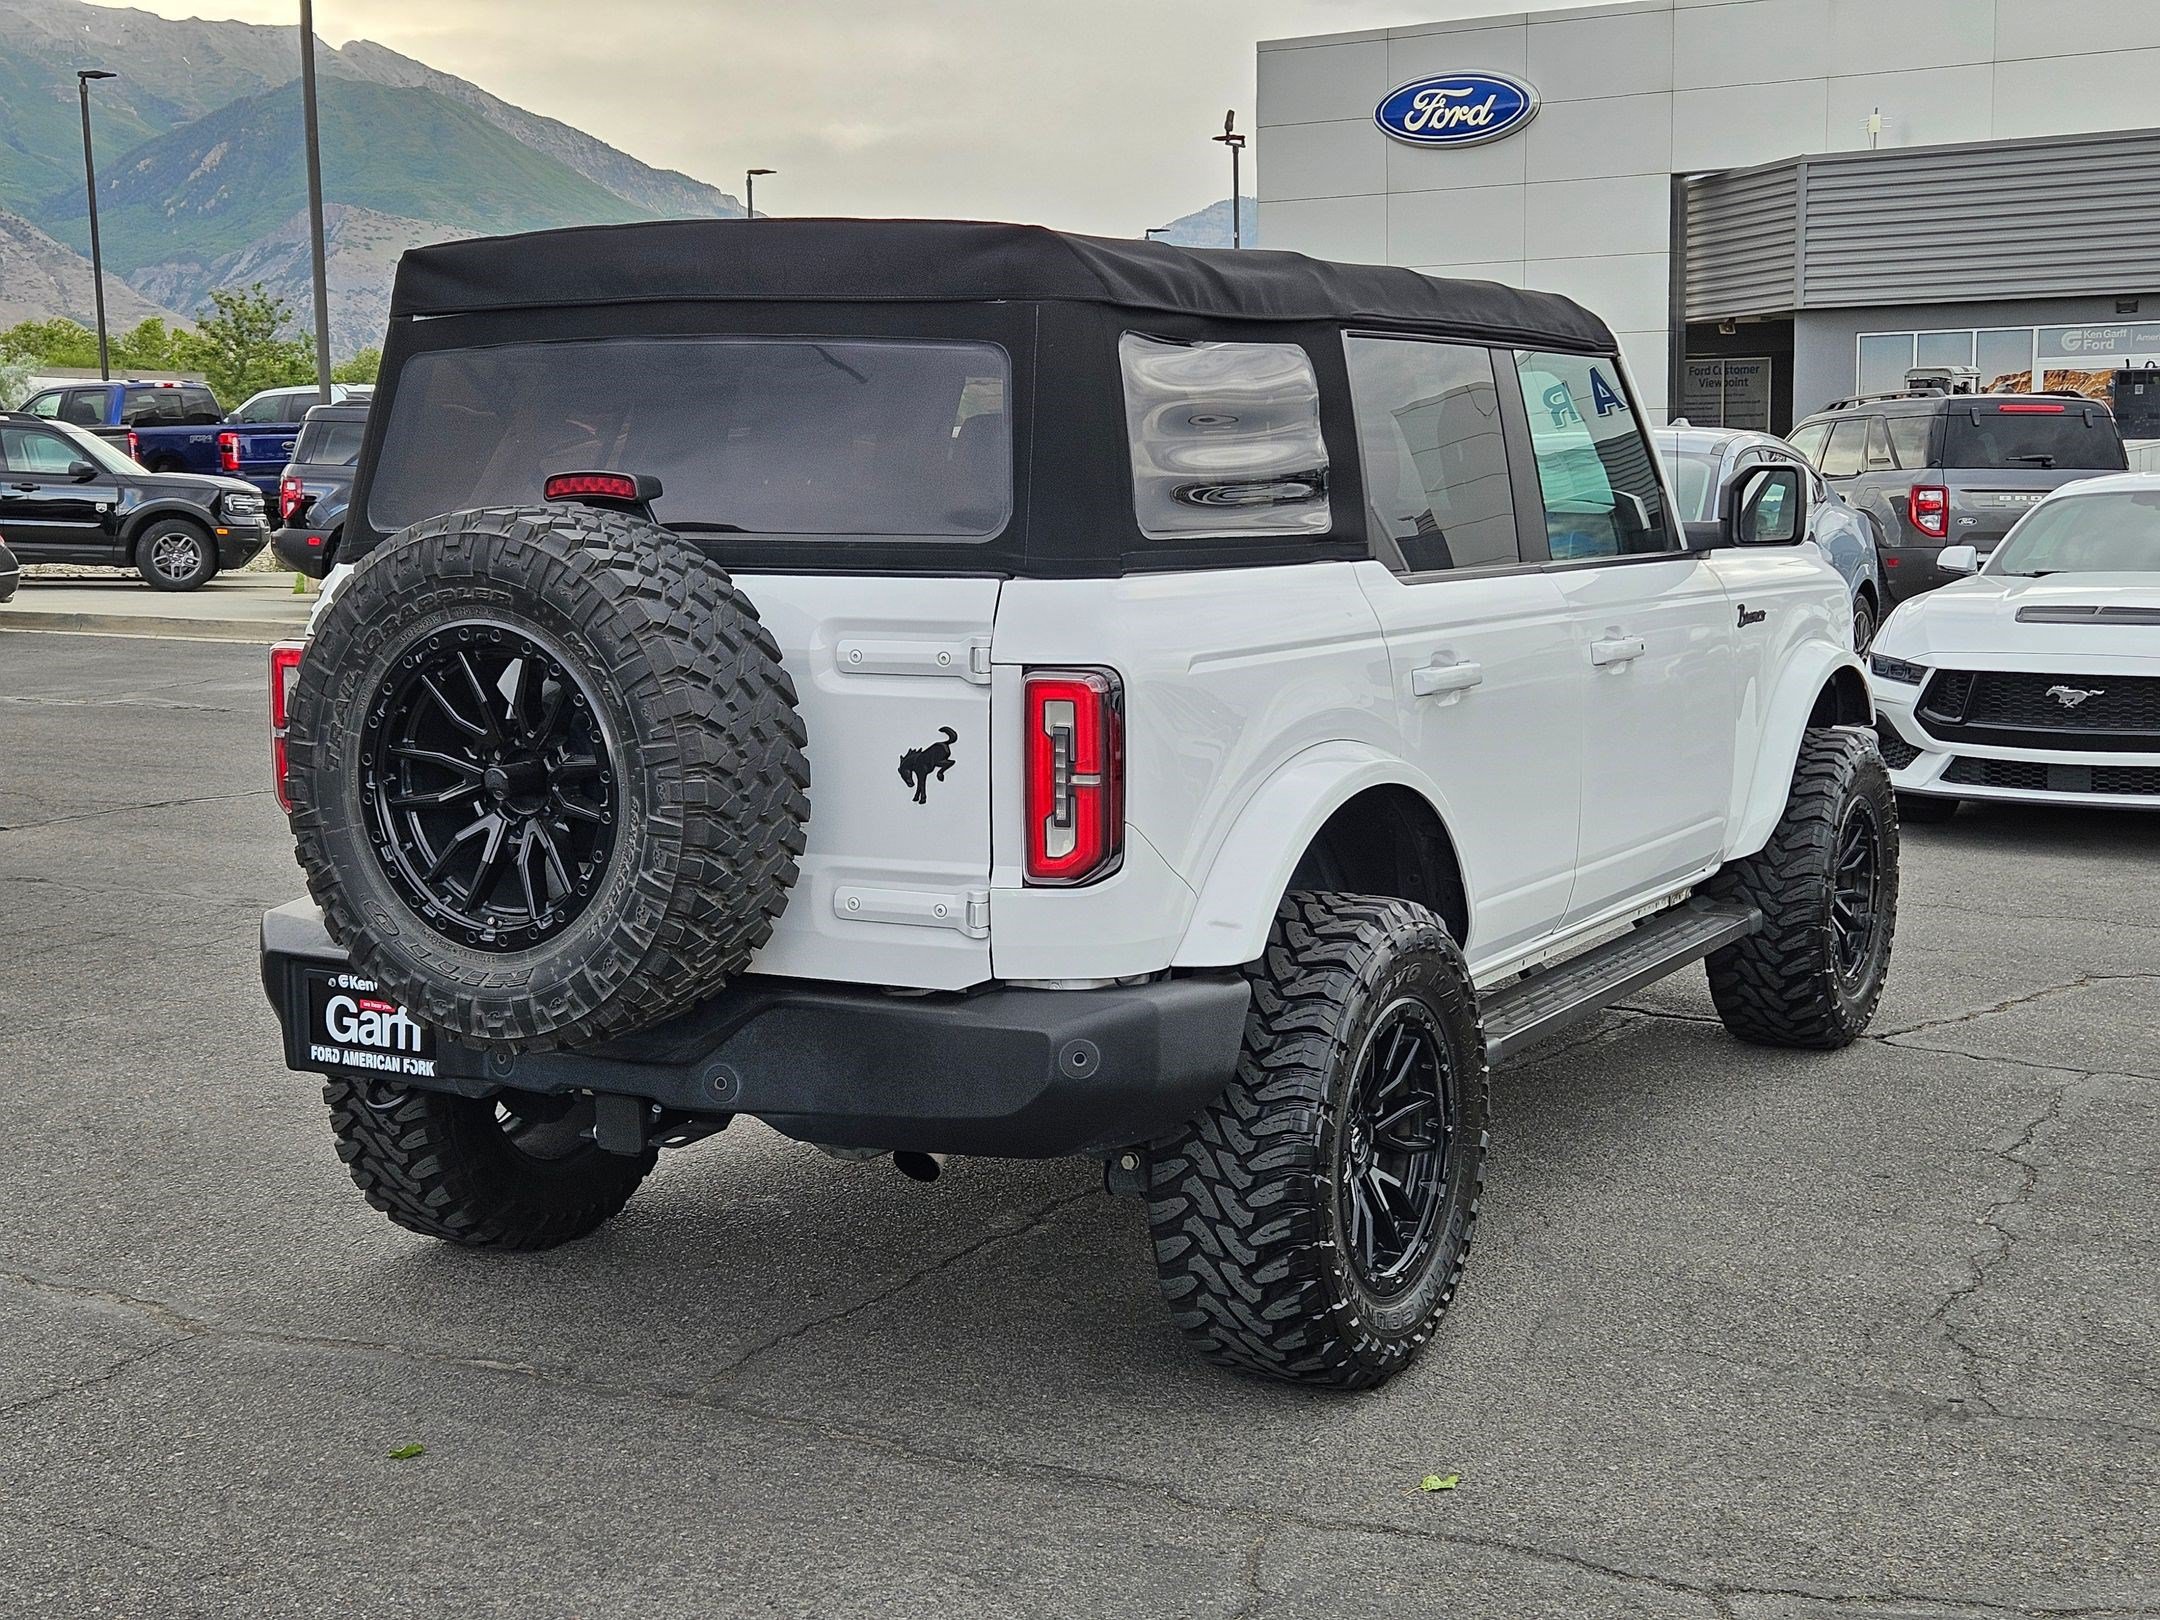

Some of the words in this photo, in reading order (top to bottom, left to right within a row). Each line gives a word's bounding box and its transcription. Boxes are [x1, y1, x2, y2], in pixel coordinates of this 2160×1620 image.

[1403, 87, 1497, 132] Ford
[2083, 331, 2102, 339] Ken
[2103, 328, 2128, 338] Garff
[2083, 339, 2115, 350] Ford
[1689, 366, 1711, 376] Ford
[1712, 365, 1760, 375] Customer
[1699, 377, 1749, 388] Viewpoint
[350, 975, 375, 991] Ken
[310, 1045, 340, 1064] FORD
[342, 1050, 401, 1072] AMERICAN
[403, 1058, 436, 1077] FORK
